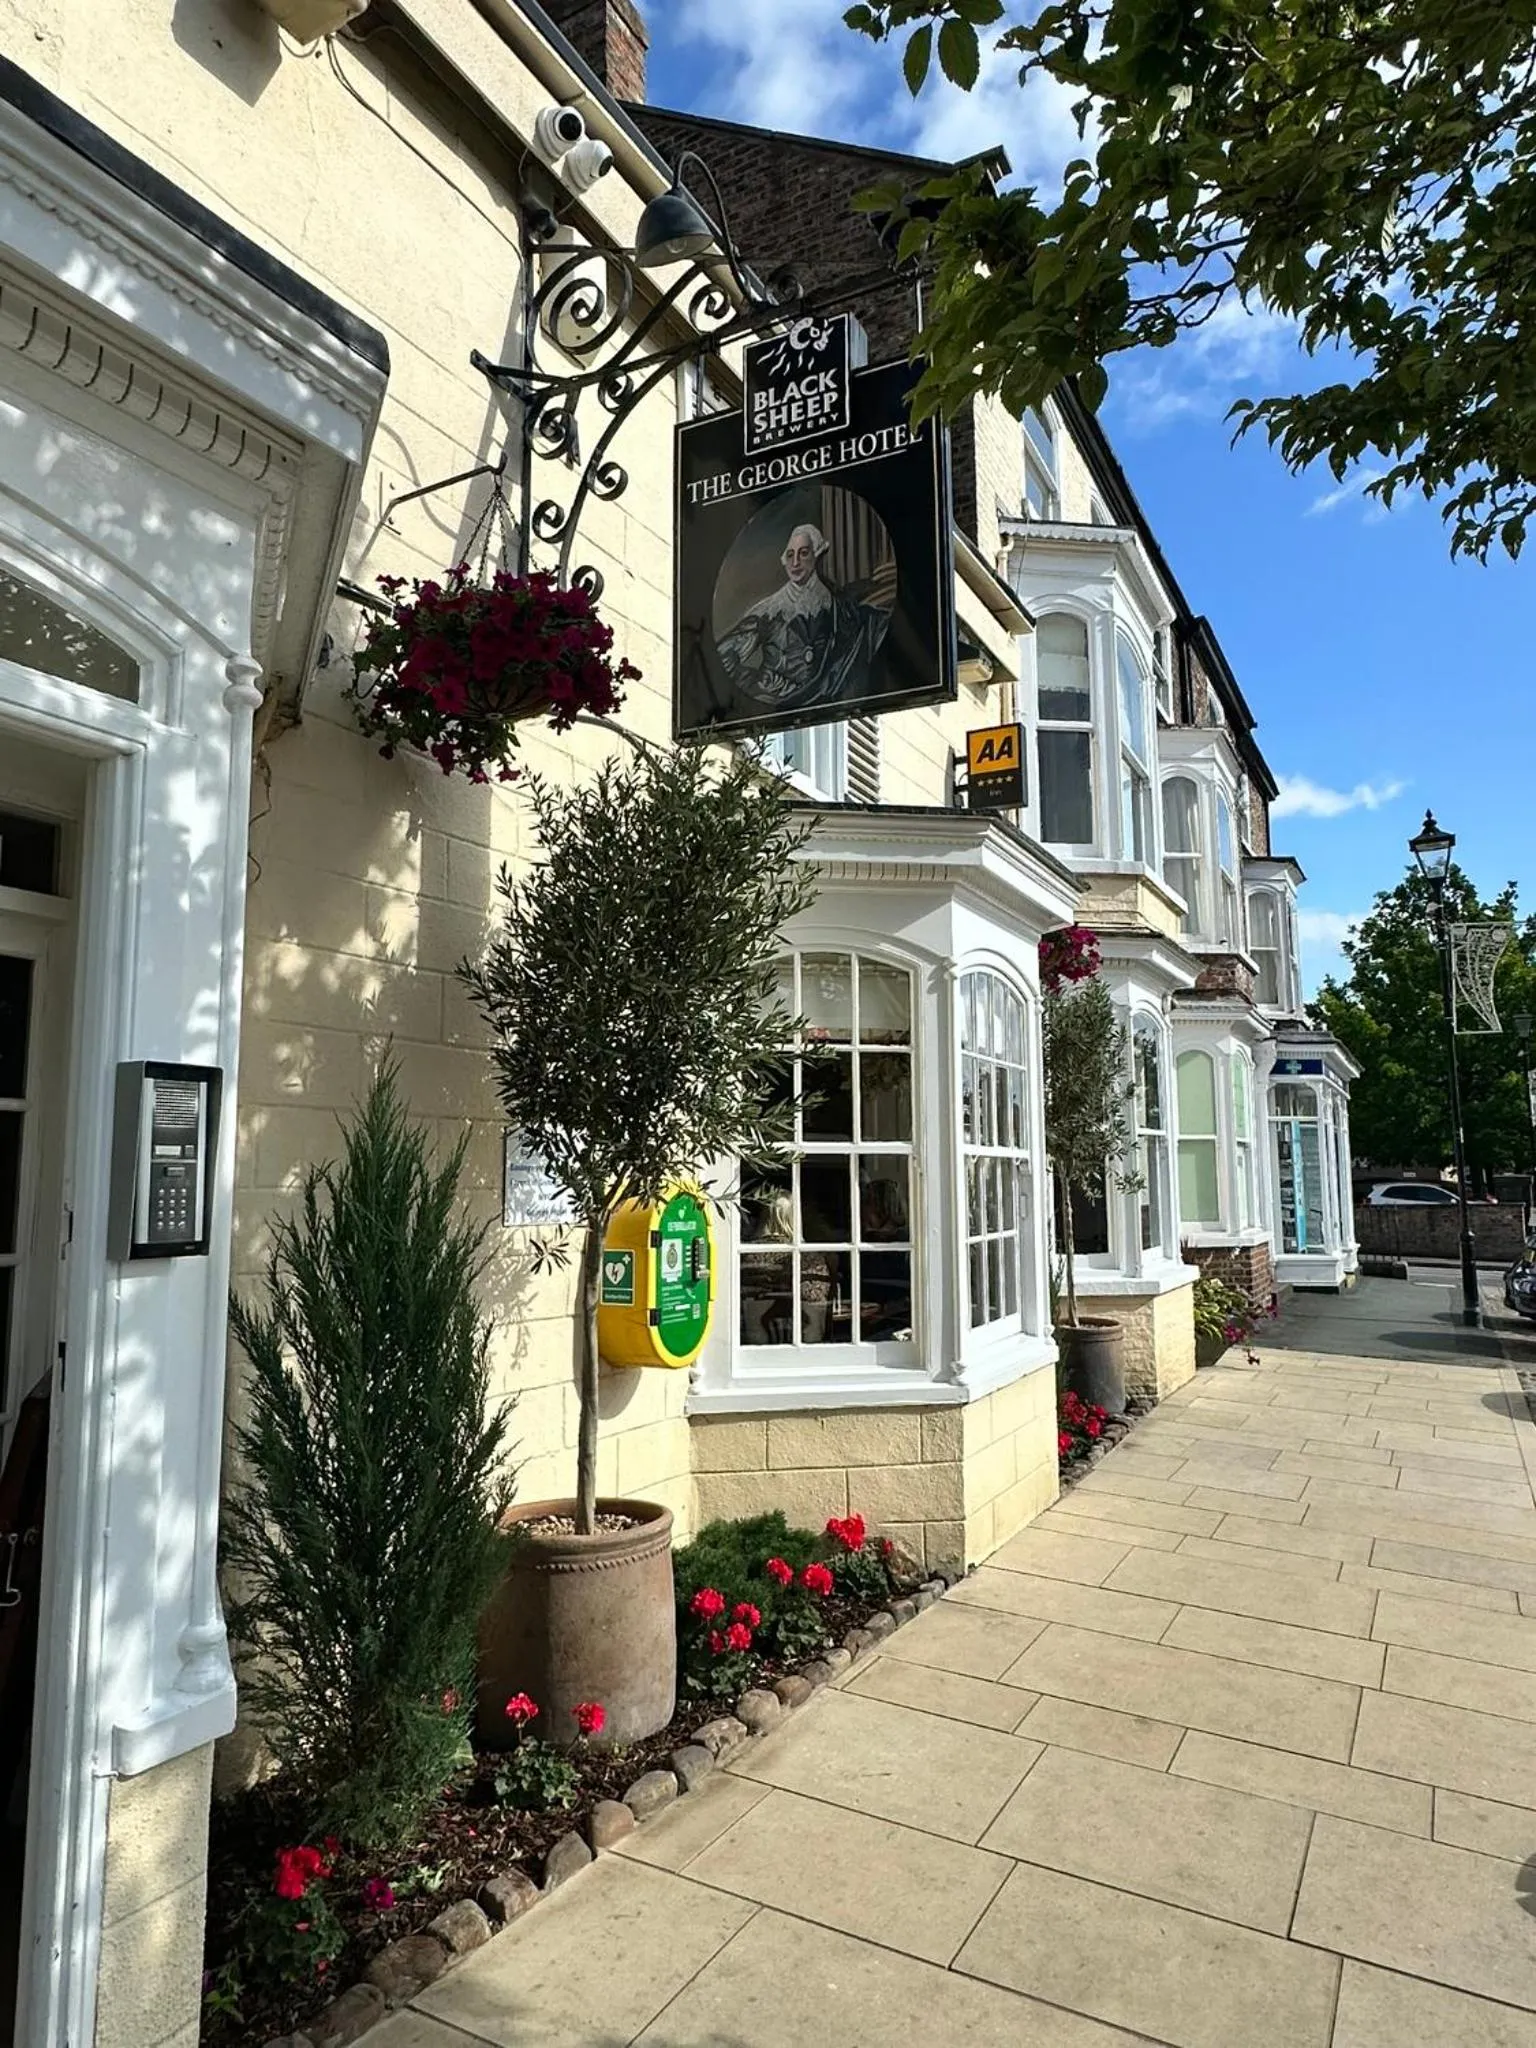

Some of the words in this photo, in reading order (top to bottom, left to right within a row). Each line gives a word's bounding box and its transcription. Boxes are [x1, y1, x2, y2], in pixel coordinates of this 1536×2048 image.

[754, 368, 838, 412] BLACK
[753, 413, 838, 444] BREWERY
[754, 391, 838, 433] SHEEP
[687, 472, 732, 503] THE
[738, 445, 833, 489] GEORGE
[976, 735, 1014, 764] AA
